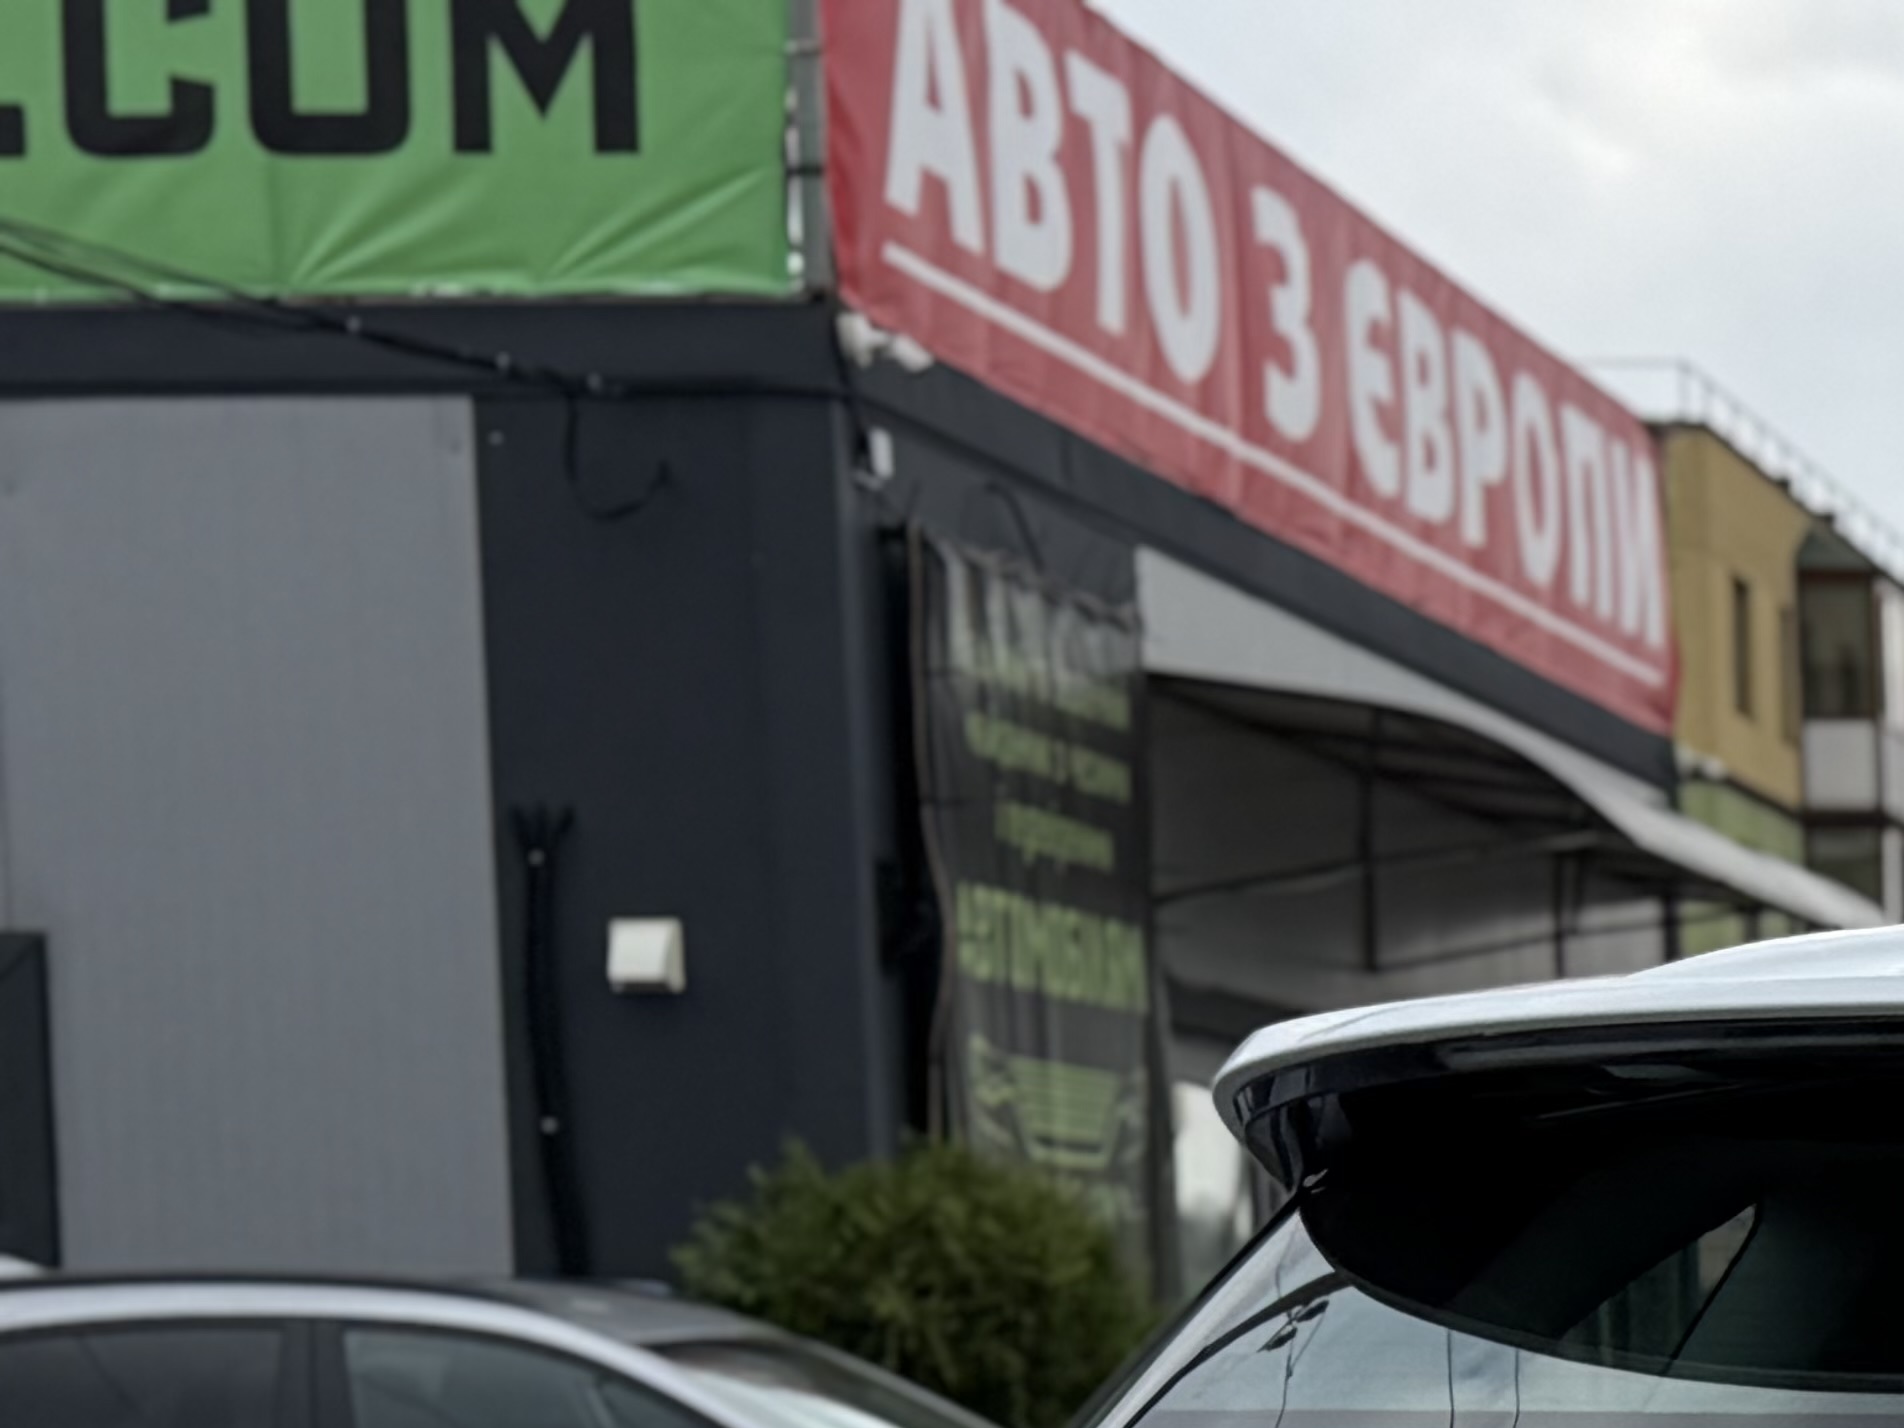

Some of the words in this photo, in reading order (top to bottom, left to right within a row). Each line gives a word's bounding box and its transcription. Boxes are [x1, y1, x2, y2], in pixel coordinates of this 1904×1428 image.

[882, 0, 1222, 387] АВТО
[1250, 184, 1322, 444] З
[1342, 257, 1667, 651] ЄВРОПИ
